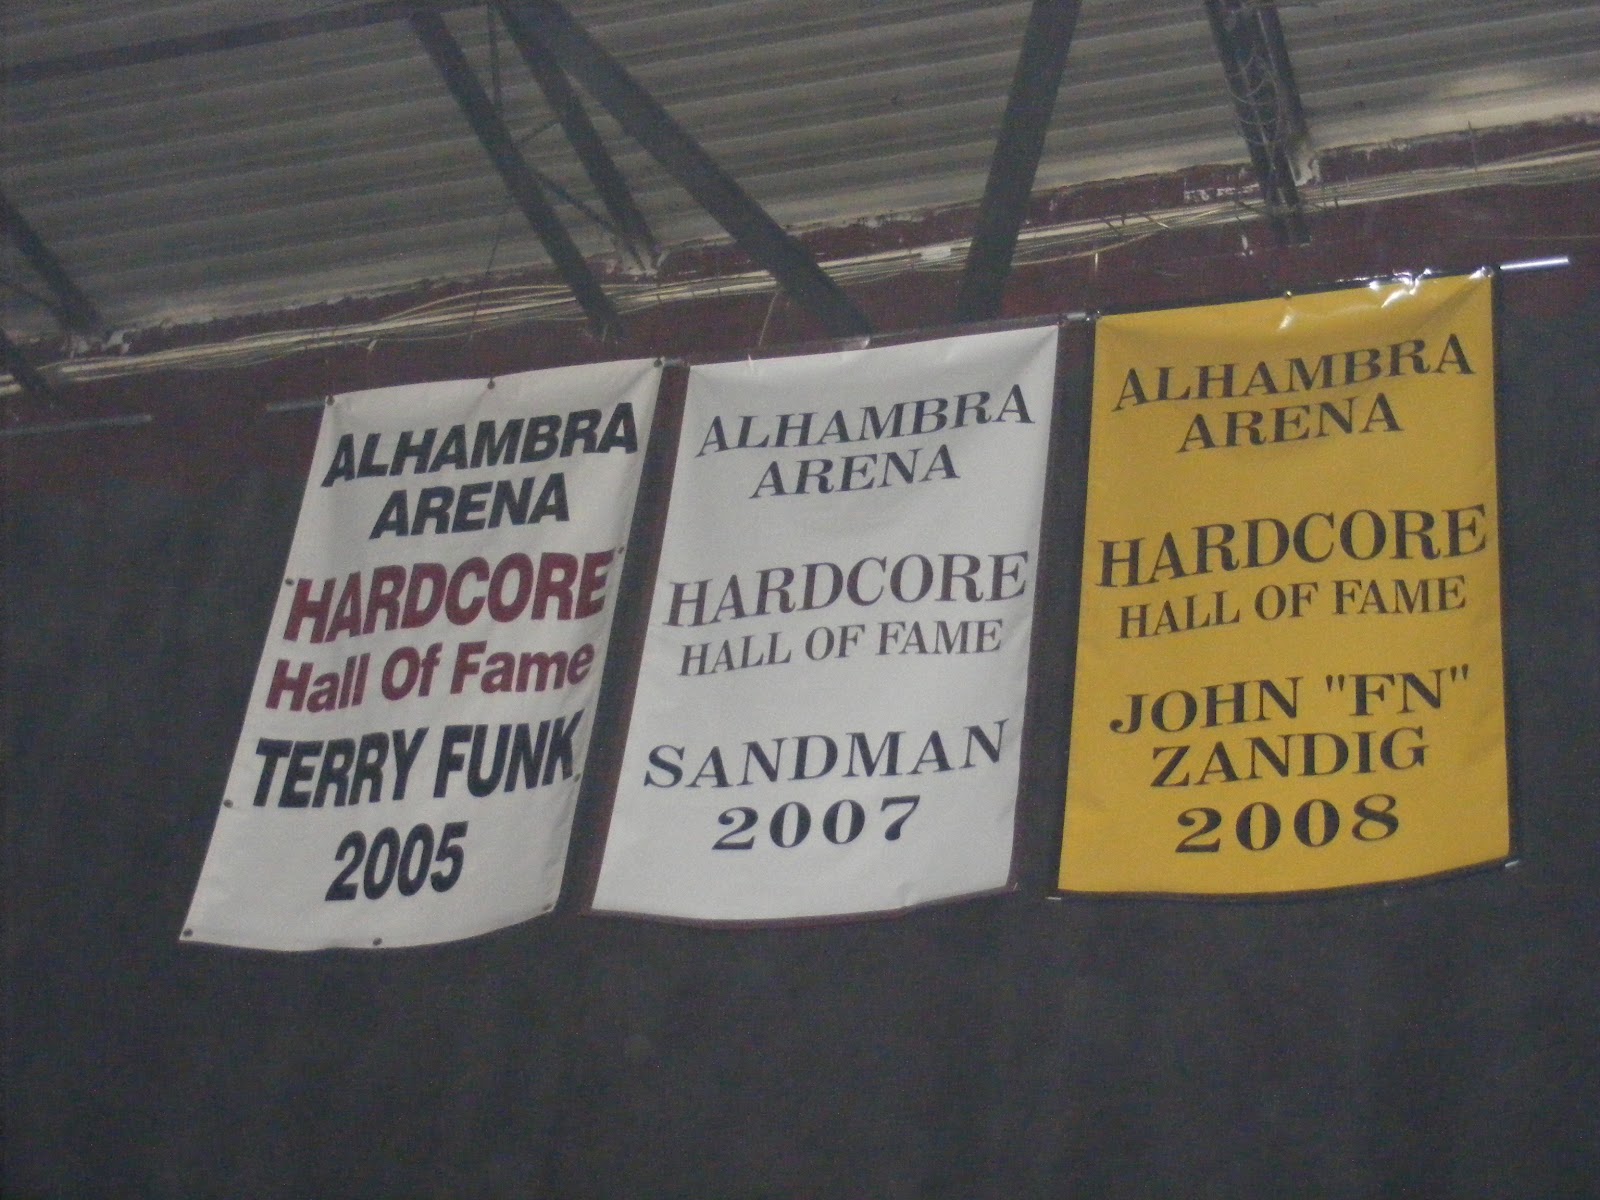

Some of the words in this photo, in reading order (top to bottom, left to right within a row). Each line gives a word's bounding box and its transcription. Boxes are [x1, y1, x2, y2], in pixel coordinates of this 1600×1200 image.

[1111, 333, 1476, 412] ALHAMBRA
[321, 402, 638, 487] ALHAMBRA
[695, 384, 1035, 457] ALHAMBRA
[1176, 393, 1404, 453] ARENA
[369, 473, 570, 540] ARENA
[749, 444, 960, 499] ARENA
[1095, 504, 1488, 589] HARDCORE
[283, 547, 615, 644] HARDCORE
[662, 551, 1029, 628] HARDCORE
[1116, 592, 1241, 639] HALL
[1254, 582, 1319, 620] OF
[1334, 575, 1467, 615] FAME
[265, 652, 370, 713] Hall
[381, 643, 442, 701] Of
[450, 640, 594, 694] Fame
[678, 632, 792, 677] HALL
[805, 624, 865, 661] OF
[876, 619, 1003, 655] FAME
[1110, 676, 1304, 735] JOHN
[1325, 664, 1470, 716] "FN"
[251, 726, 430, 808] TERRY
[434, 709, 585, 798] FUNK
[643, 719, 1010, 788] SANDMAN
[1150, 727, 1430, 788] ZANDIG
[712, 795, 920, 850] 2007
[1175, 794, 1399, 853] 2008
[325, 821, 469, 902] 2005
